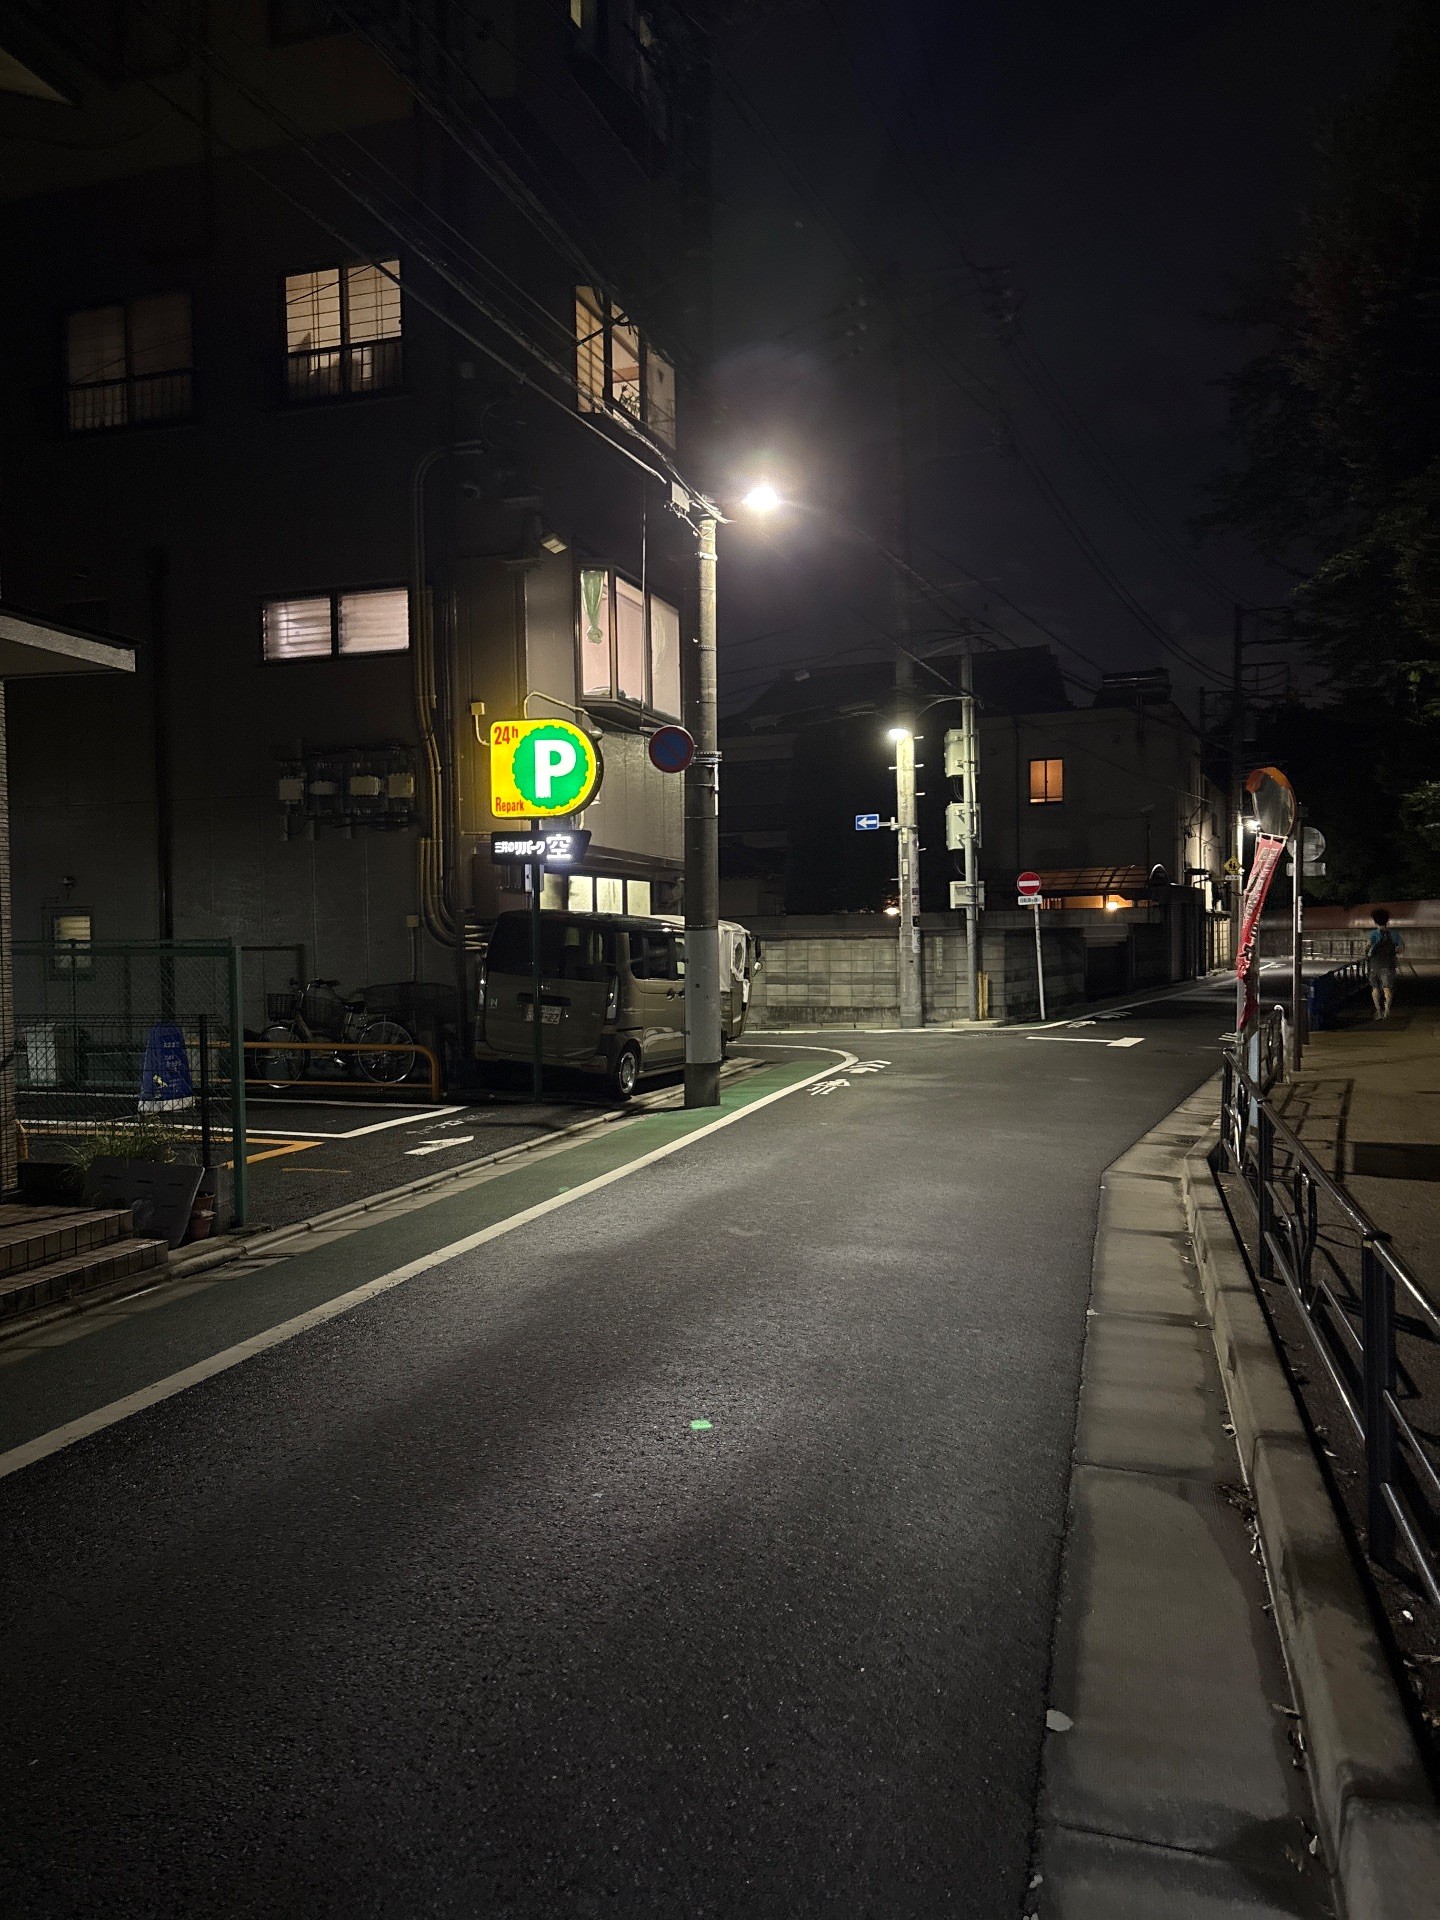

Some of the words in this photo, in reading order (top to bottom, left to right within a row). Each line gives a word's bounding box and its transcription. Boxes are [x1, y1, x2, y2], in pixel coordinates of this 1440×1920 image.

[494, 726, 519, 745] 24h
[534, 739, 576, 799] P
[495, 797, 525, 814] Repark
[545, 833, 572, 859] 空
